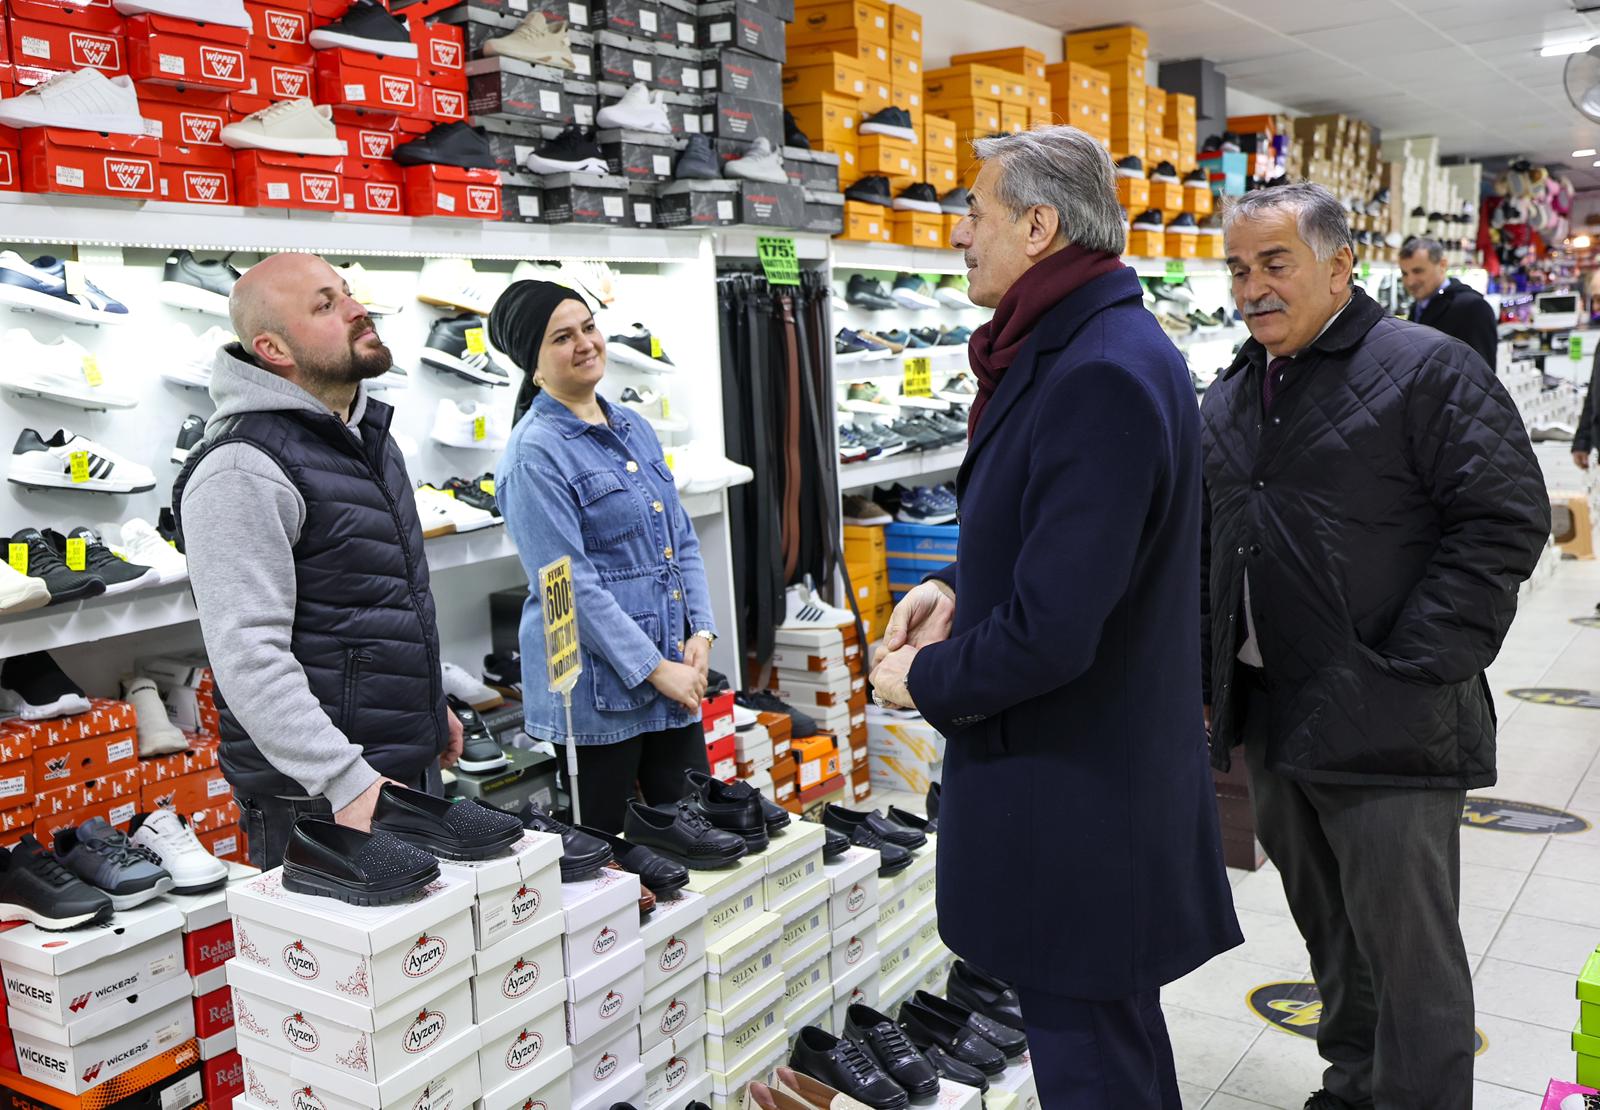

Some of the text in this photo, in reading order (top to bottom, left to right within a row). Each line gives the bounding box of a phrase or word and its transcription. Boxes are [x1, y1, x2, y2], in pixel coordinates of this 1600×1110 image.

[759, 244, 790, 257] 175
[546, 577, 569, 626] 600
[596, 935, 615, 950] Ayzen
[287, 951, 316, 971] Ayzen
[408, 946, 441, 971] Ayzen
[663, 947, 684, 967] Ayzen
[507, 970, 536, 994] Ayzen
[602, 998, 621, 1015] Ayzen
[664, 1007, 685, 1029] Ayzen
[287, 1023, 316, 1044] Ayzen
[408, 1020, 441, 1046] Ayzen
[510, 1040, 539, 1065] Ayzen
[596, 1060, 616, 1077] Ayzen
